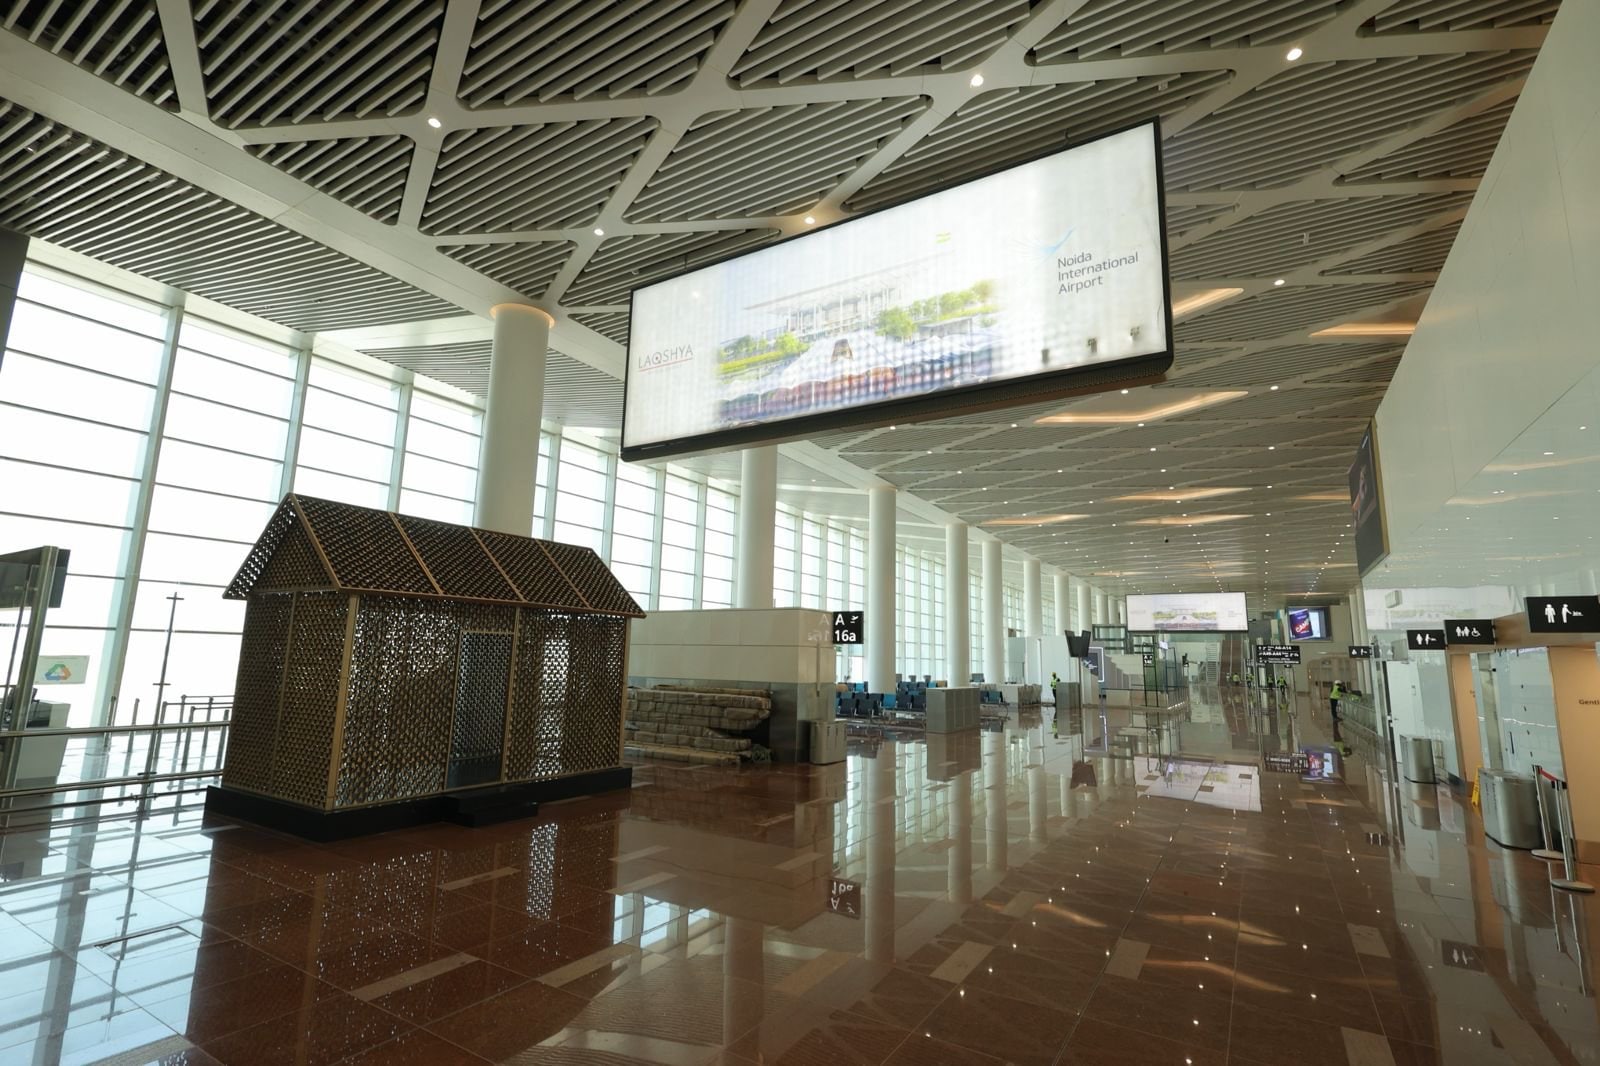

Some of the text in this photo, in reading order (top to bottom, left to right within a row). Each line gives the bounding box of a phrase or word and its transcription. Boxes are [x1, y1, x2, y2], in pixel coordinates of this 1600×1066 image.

[1058, 252, 1092, 269] Noida
[1058, 251, 1139, 281] International
[1058, 276, 1103, 295] Airport
[638, 344, 694, 369] LAQSHYA
[835, 613, 845, 626] A
[834, 629, 857, 642] 16a
